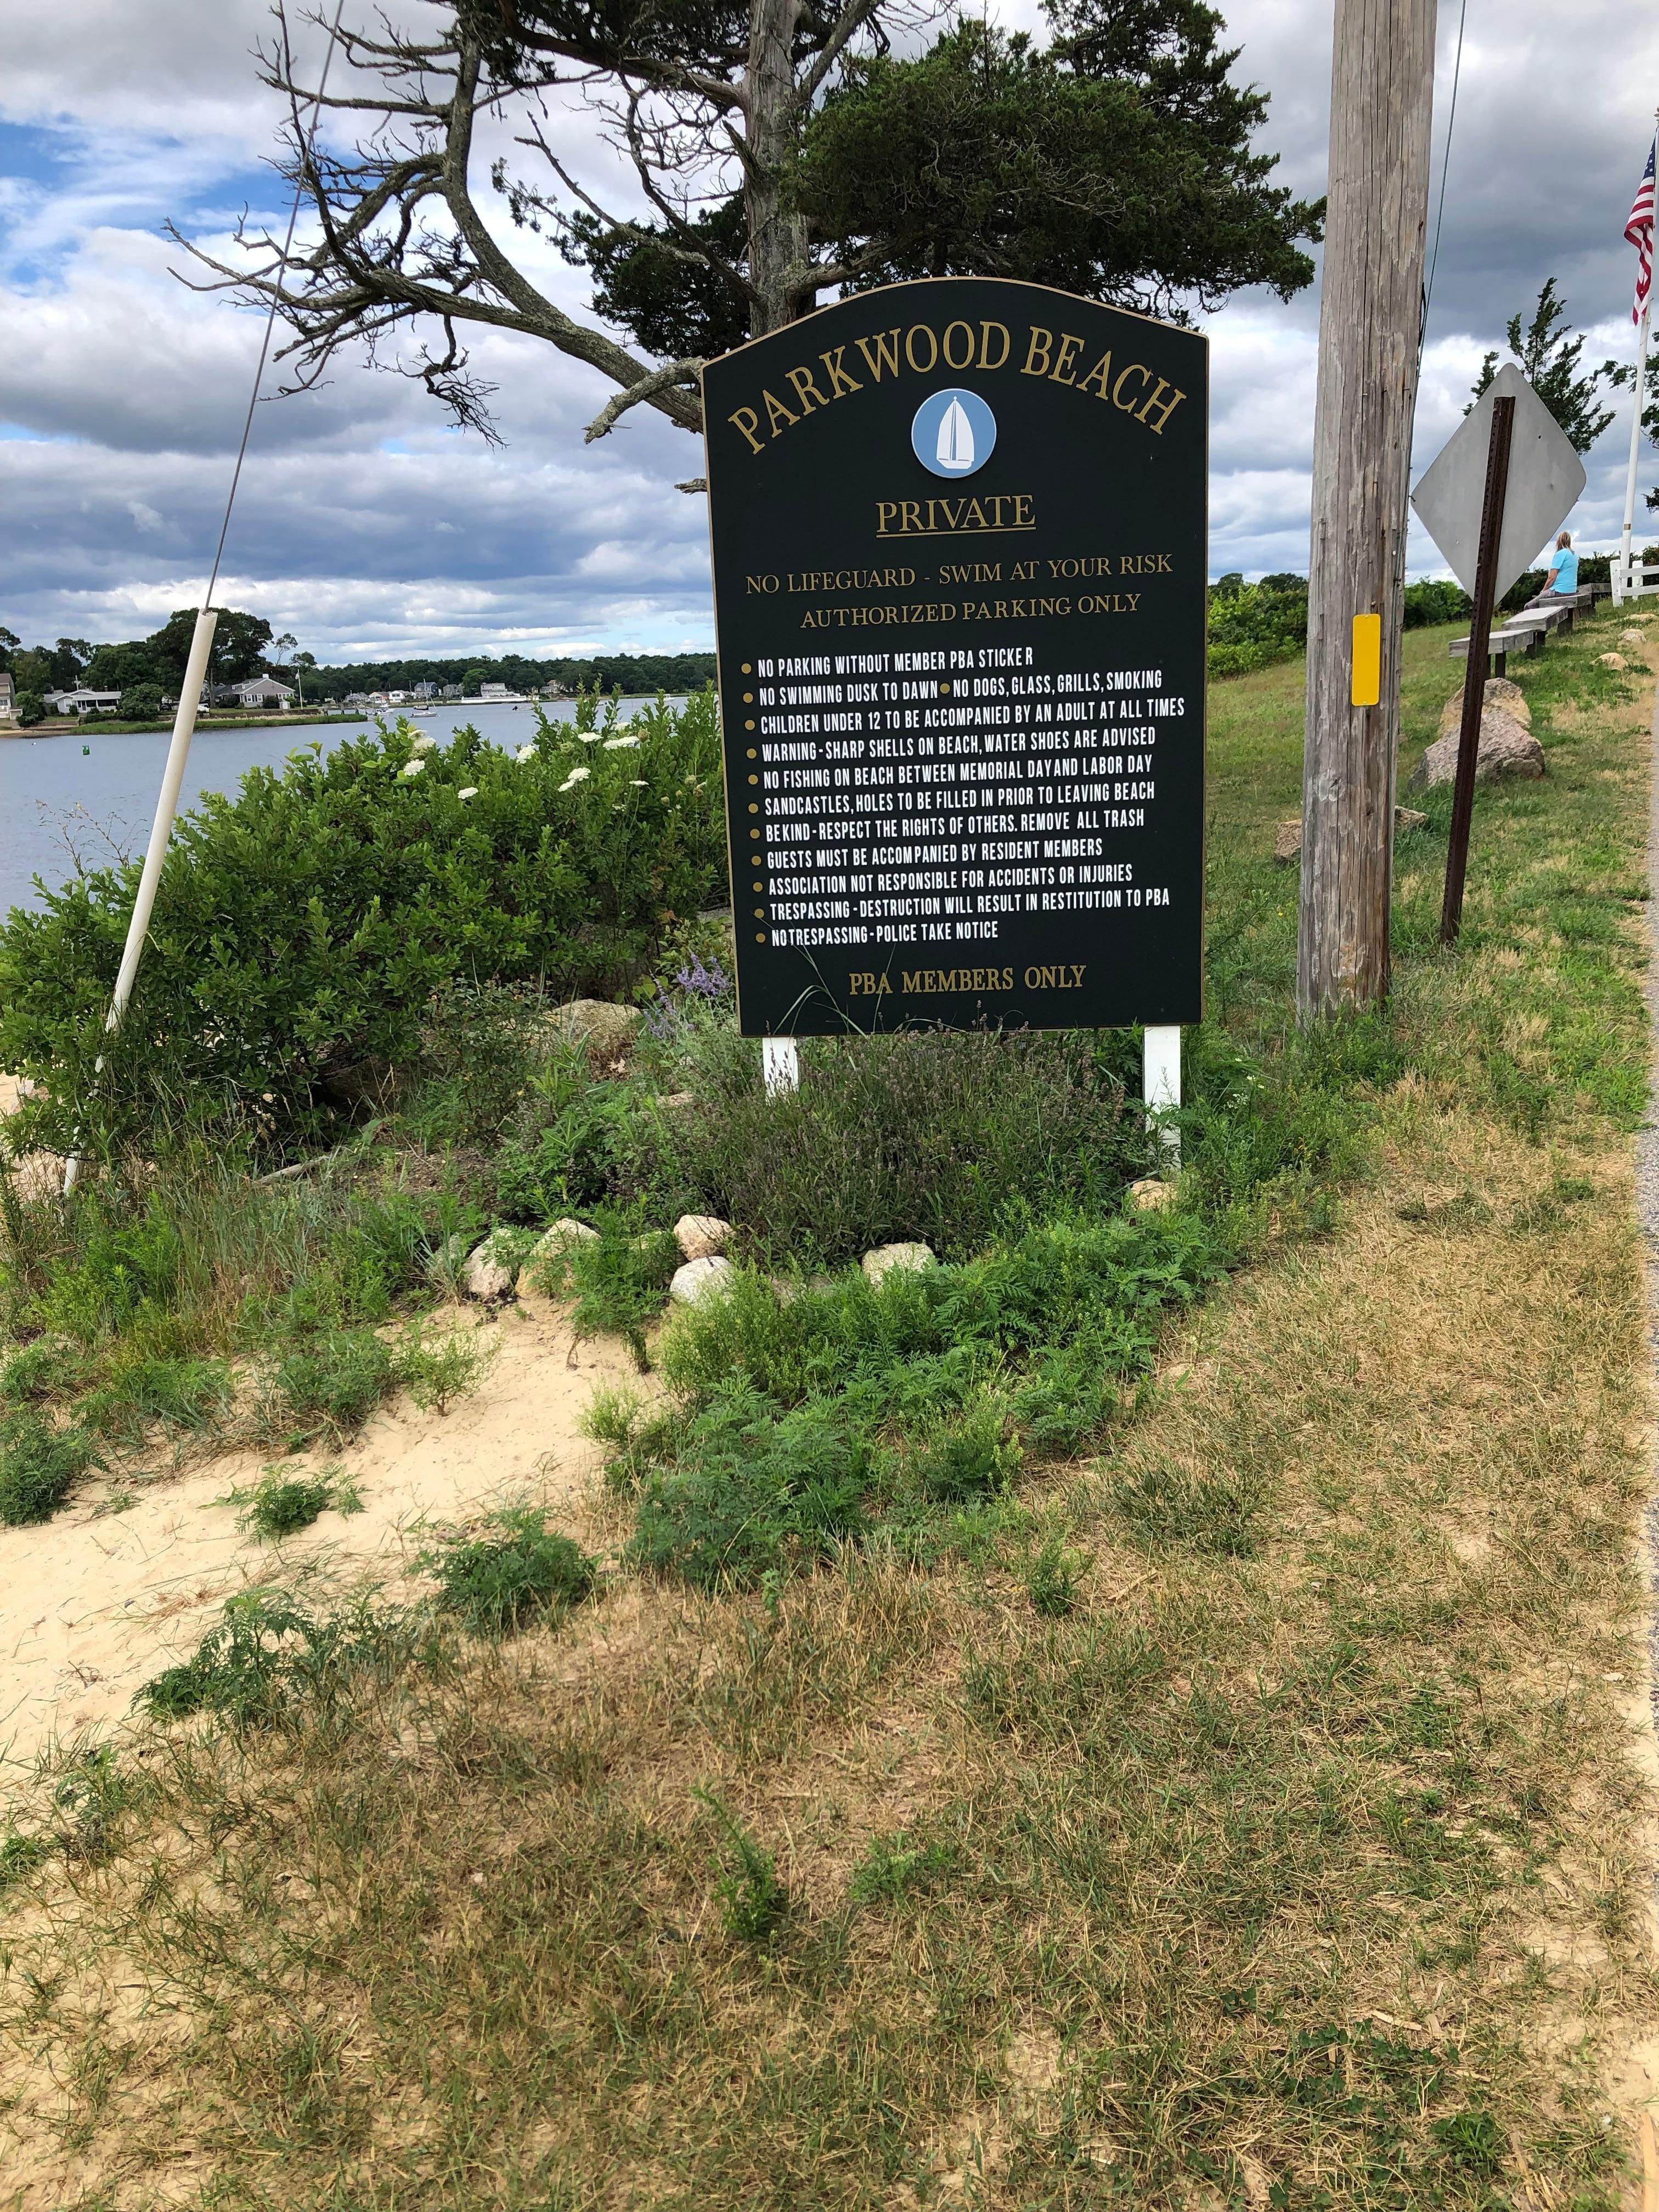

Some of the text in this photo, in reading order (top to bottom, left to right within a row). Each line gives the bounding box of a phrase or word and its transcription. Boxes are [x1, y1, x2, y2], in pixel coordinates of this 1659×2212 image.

[727, 320, 1187, 454] PARKWOOD BEACH
[876, 495, 1035, 532] PRIVATE
[746, 575, 779, 593] NO
[787, 568, 915, 591] LIFEGUARD
[940, 563, 1002, 584] SWIM
[1010, 561, 1039, 580] AT
[1047, 558, 1111, 578] YOUR
[1120, 554, 1173, 574] RISK
[800, 594, 1141, 628] AUTHORIZED PARKING ONLY
[758, 647, 1032, 677] NO PARKING WITHOUT MEMBER PBA STICKER
[760, 687, 775, 706] NO
[780, 685, 842, 705] SWIMMING
[847, 683, 878, 702] DUSK
[883, 682, 898, 700] TO
[903, 681, 937, 699] DAWN
[953, 679, 968, 697] NO
[761, 698, 1184, 734] CHILDREN UNDER 12 TO BE ACCOMPANIED BY AN ADULT AT ALL TIMES
[870, 738, 913, 757] SHELLS
[919, 737, 933, 755] ON
[1031, 731, 1069, 750] SHOES
[1074, 730, 1097, 748] ARE
[1103, 727, 1155, 747] ADVISED
[764, 771, 778, 789] NO
[784, 769, 830, 788] FISHING
[834, 768, 849, 786] ON
[855, 766, 893, 785] BEACH
[899, 764, 955, 783] BETWEEN
[960, 761, 1023, 781] MEMORIAL
[1083, 756, 1122, 775] LABOR
[1128, 754, 1152, 772] DAY
[898, 793, 912, 810] TO
[936, 790, 976, 808] FILLED
[982, 789, 992, 806] IN
[998, 787, 1032, 805] PRIOR
[1038, 786, 1052, 804] TO
[1058, 783, 1109, 803] LEAVING
[1115, 782, 1154, 800] BEACH
[766, 825, 780, 842] BE
[875, 820, 897, 837] THE
[902, 817, 945, 836] RIGHTS
[950, 817, 963, 834] OF
[1077, 811, 1099, 828] ALL
[1104, 809, 1143, 827] TRASH
[768, 838, 1102, 869] GUESTS MUST BE ACCOMPANIED BY RESIDENT MEMBERS
[769, 864, 1132, 895] ASSOCIATION NOT RESPONSIBLE FOR ACCIDENTS OR INJURIES
[945, 896, 973, 913] WILL
[978, 894, 1021, 912] RESULT
[1026, 894, 1037, 911] IN
[1042, 890, 1121, 910] RESTITUTION
[1126, 889, 1141, 906] TO
[1146, 888, 1169, 906] PBA
[772, 929, 787, 946] NO
[921, 923, 951, 940] TAKE
[956, 921, 998, 939] NOTICE
[849, 966, 1086, 995] PBA MEMBERS ONLY
